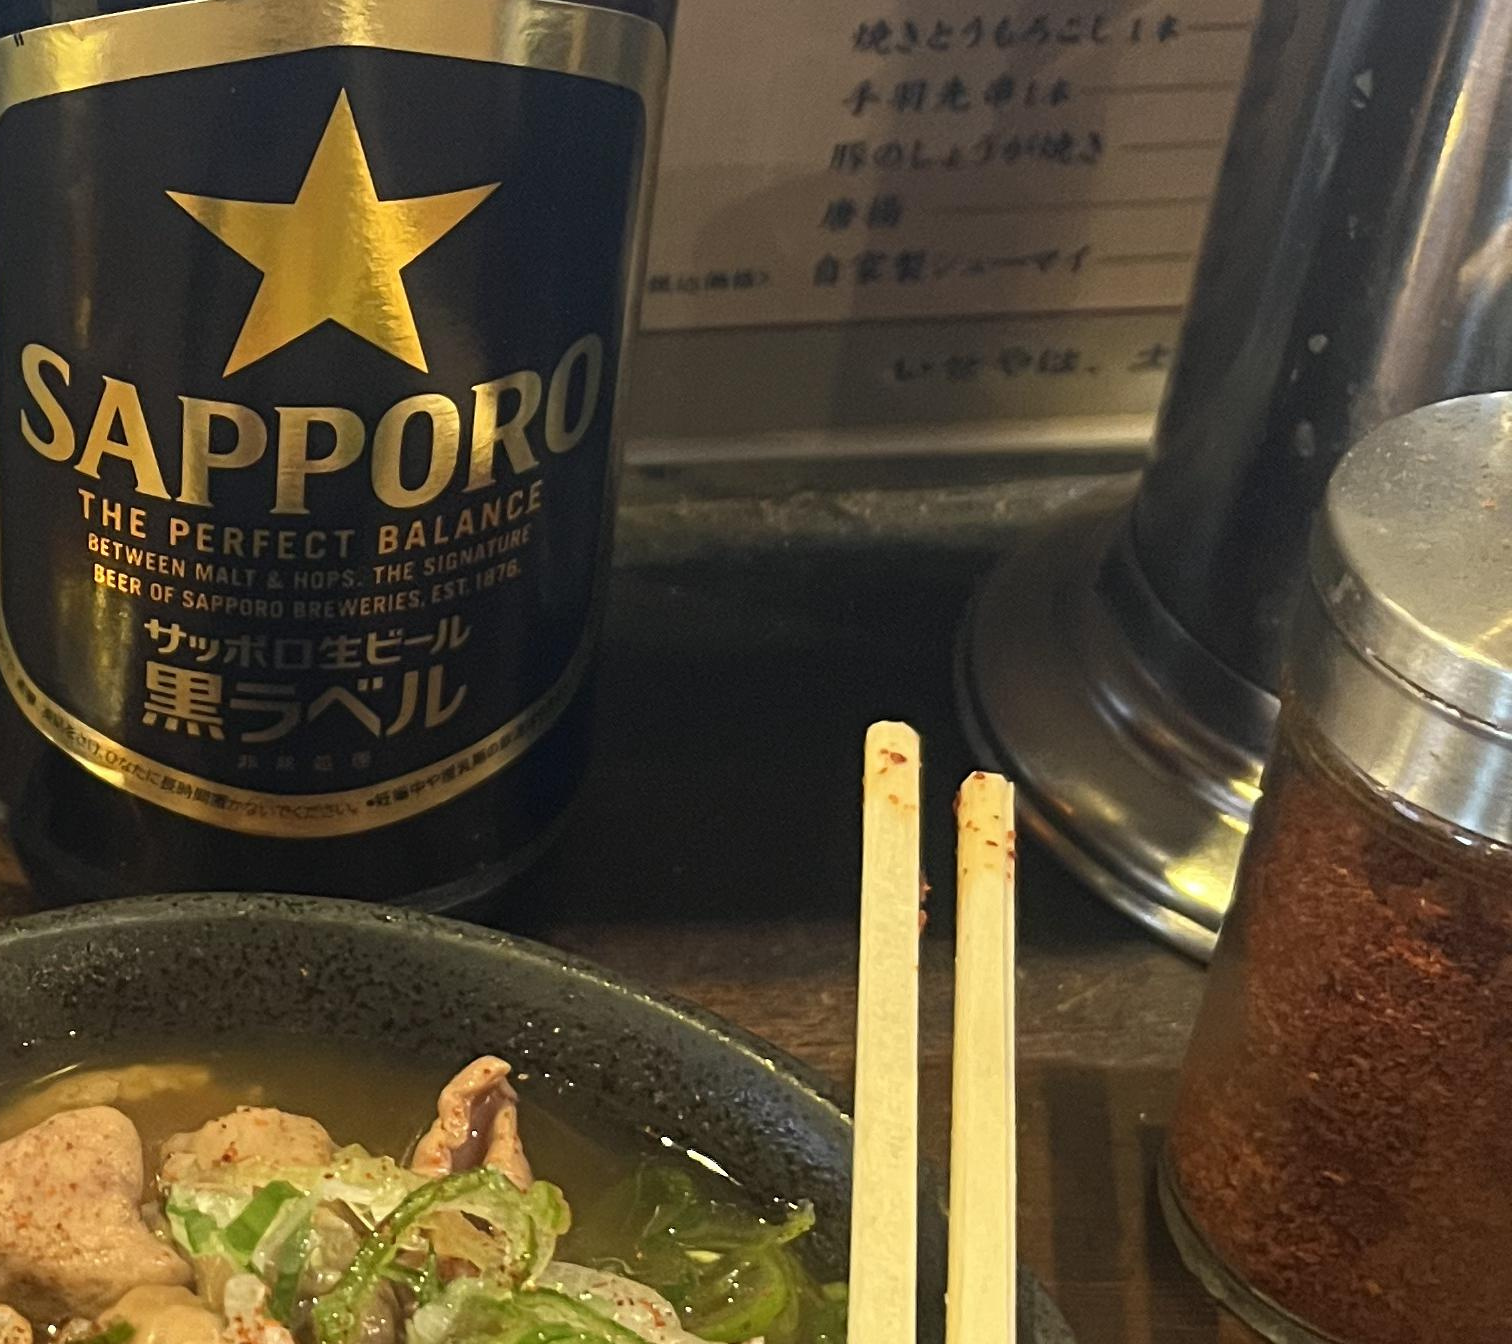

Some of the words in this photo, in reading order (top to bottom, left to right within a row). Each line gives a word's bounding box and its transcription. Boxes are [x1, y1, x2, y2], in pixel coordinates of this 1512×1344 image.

[20, 336, 603, 515] SAPPORO
[78, 488, 147, 539] THE
[169, 517, 356, 559] PERFECT
[378, 479, 544, 555] BALANCE
[88, 532, 186, 578] BETWEEN
[195, 562, 256, 587] MALT
[373, 560, 415, 584] THE
[423, 523, 534, 576] SIGNATURE
[93, 563, 142, 596] BEER
[150, 582, 175, 603] OF
[182, 589, 284, 619] SAPPORO
[143, 614, 473, 670] サッポロ生ビール
[141, 660, 468, 743] 黒ラベル
